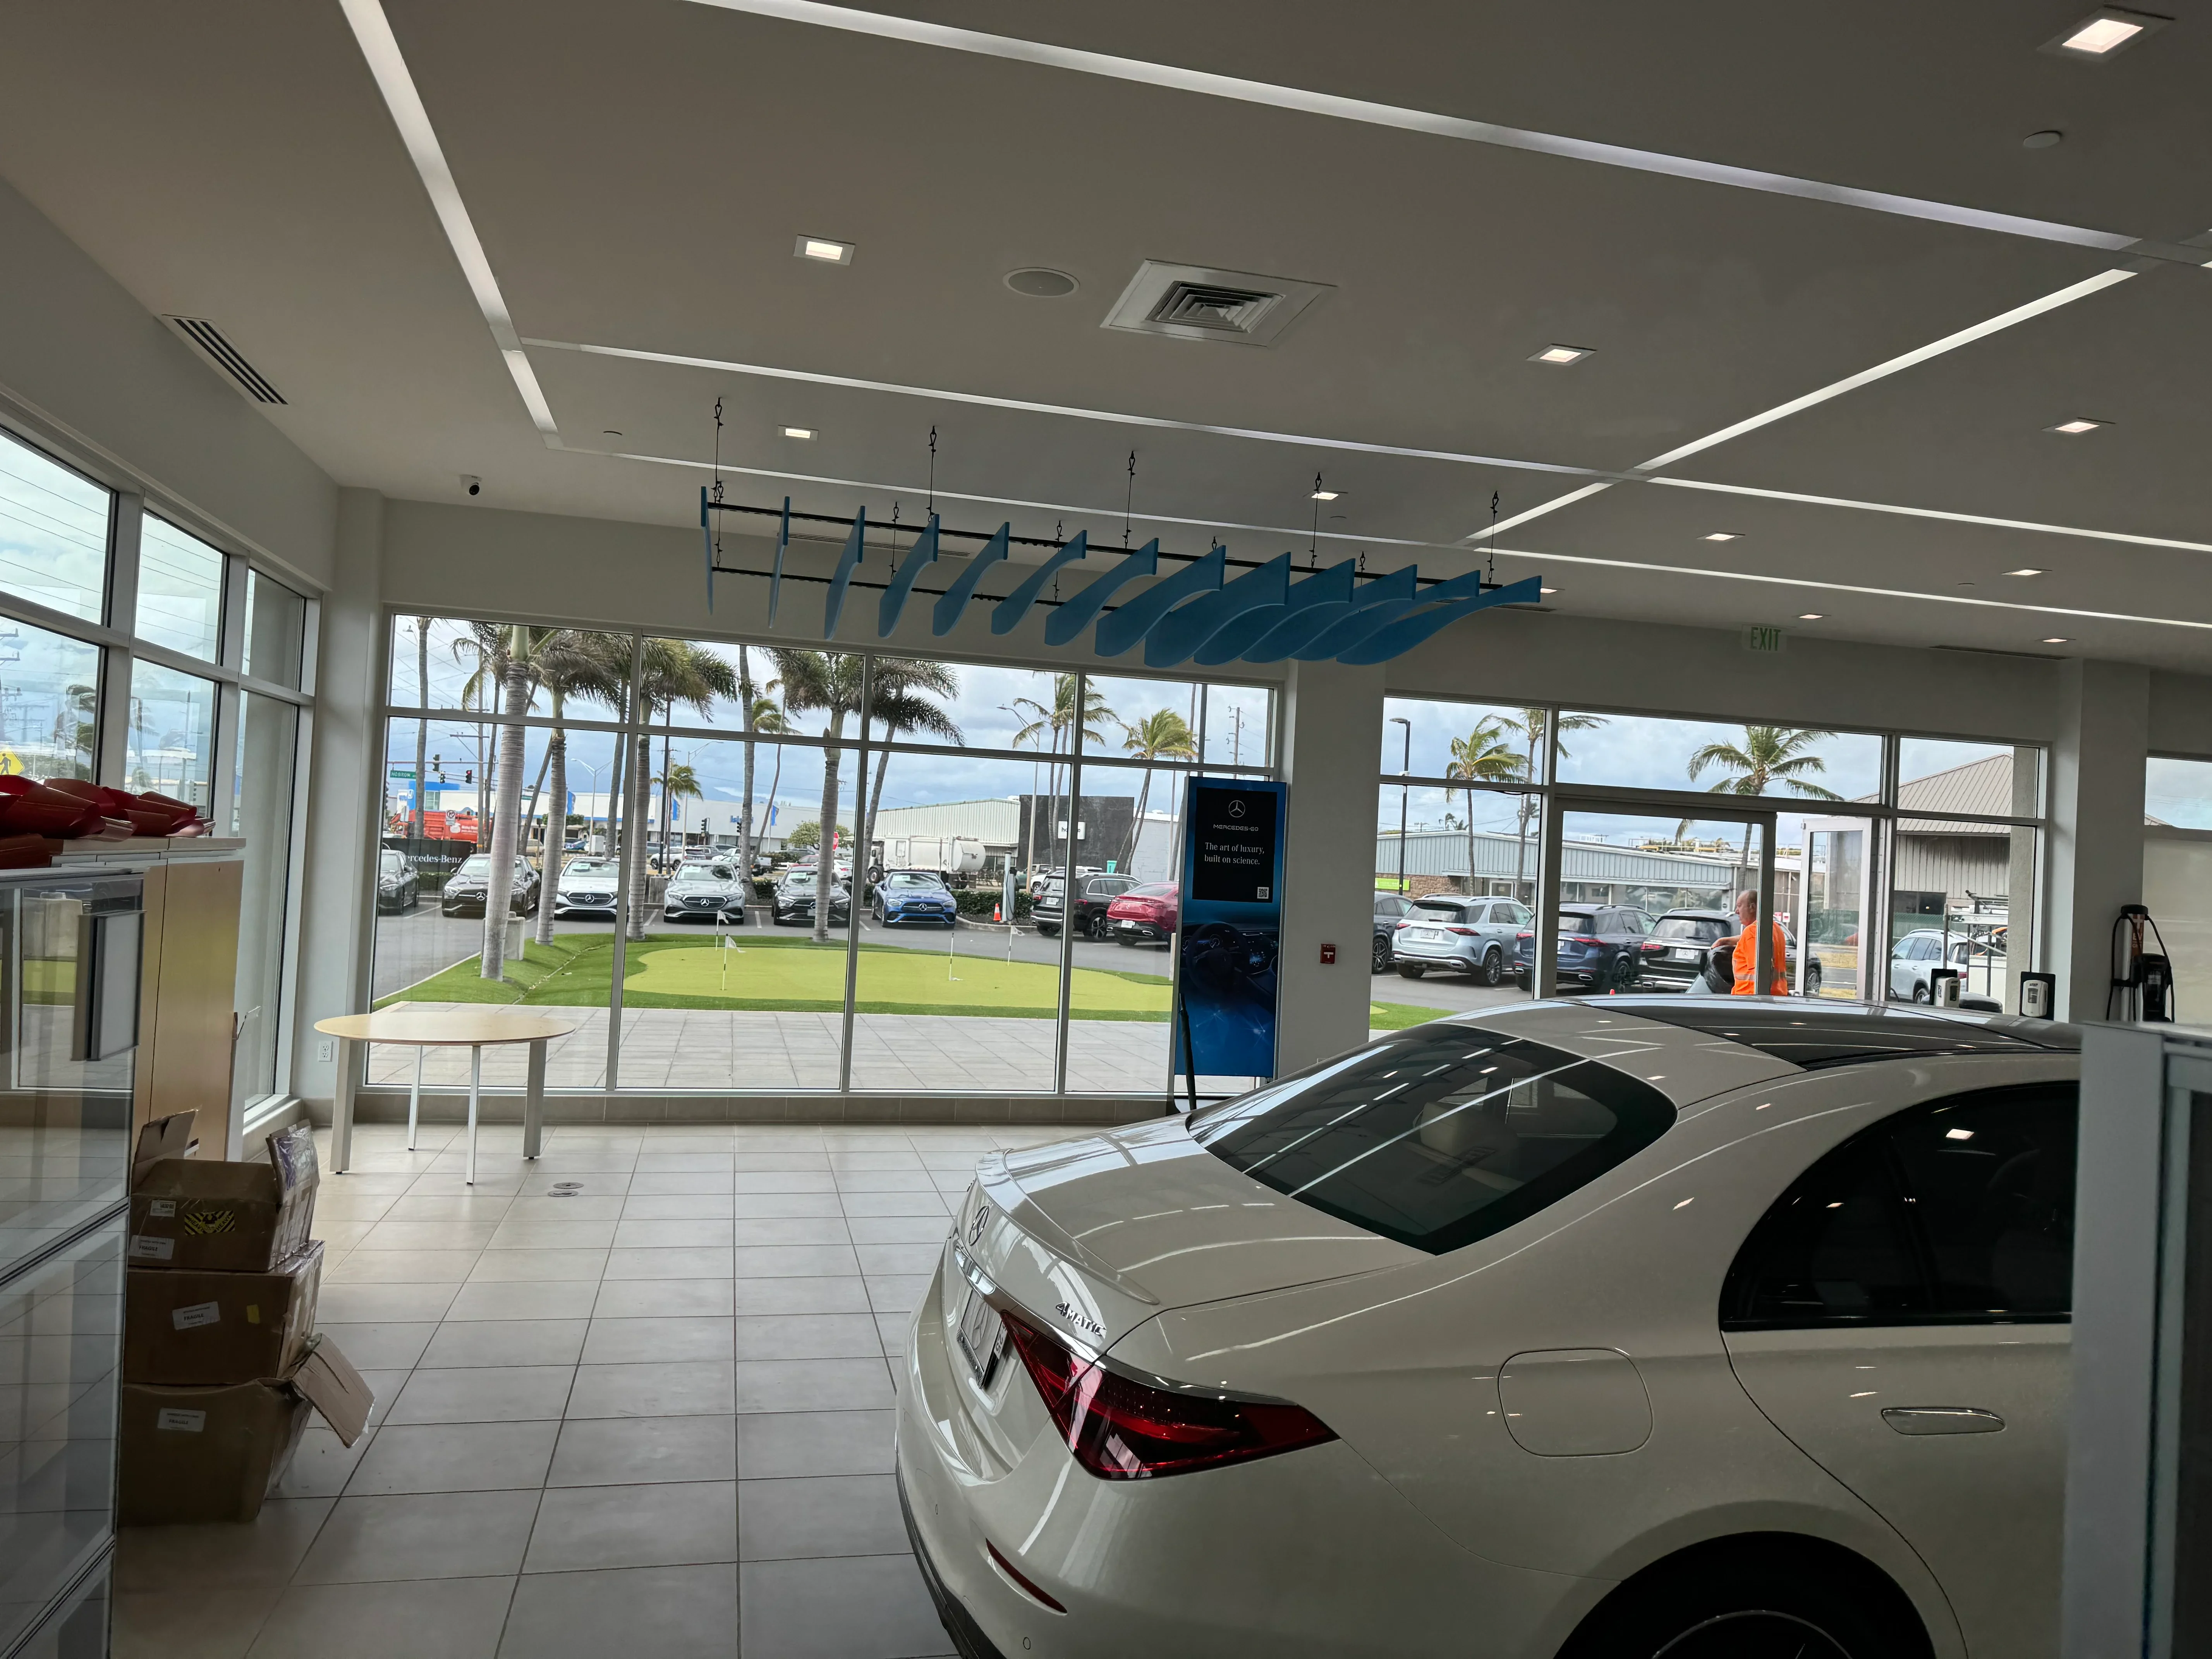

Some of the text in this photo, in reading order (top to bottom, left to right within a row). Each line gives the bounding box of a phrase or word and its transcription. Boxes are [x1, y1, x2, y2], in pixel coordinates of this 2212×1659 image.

[1750, 627, 1781, 651] EXIT
[1205, 842, 1218, 850] The
[1240, 844, 1264, 855] luxury,
[1204, 854, 1220, 863] built
[1233, 856, 1260, 865] science.
[189, 1218, 204, 1231] HEAVY
[216, 1215, 231, 1231] HEAVY
[184, 1313, 204, 1321] FRAGILE
[1055, 1301, 1104, 1336] 4MATIC
